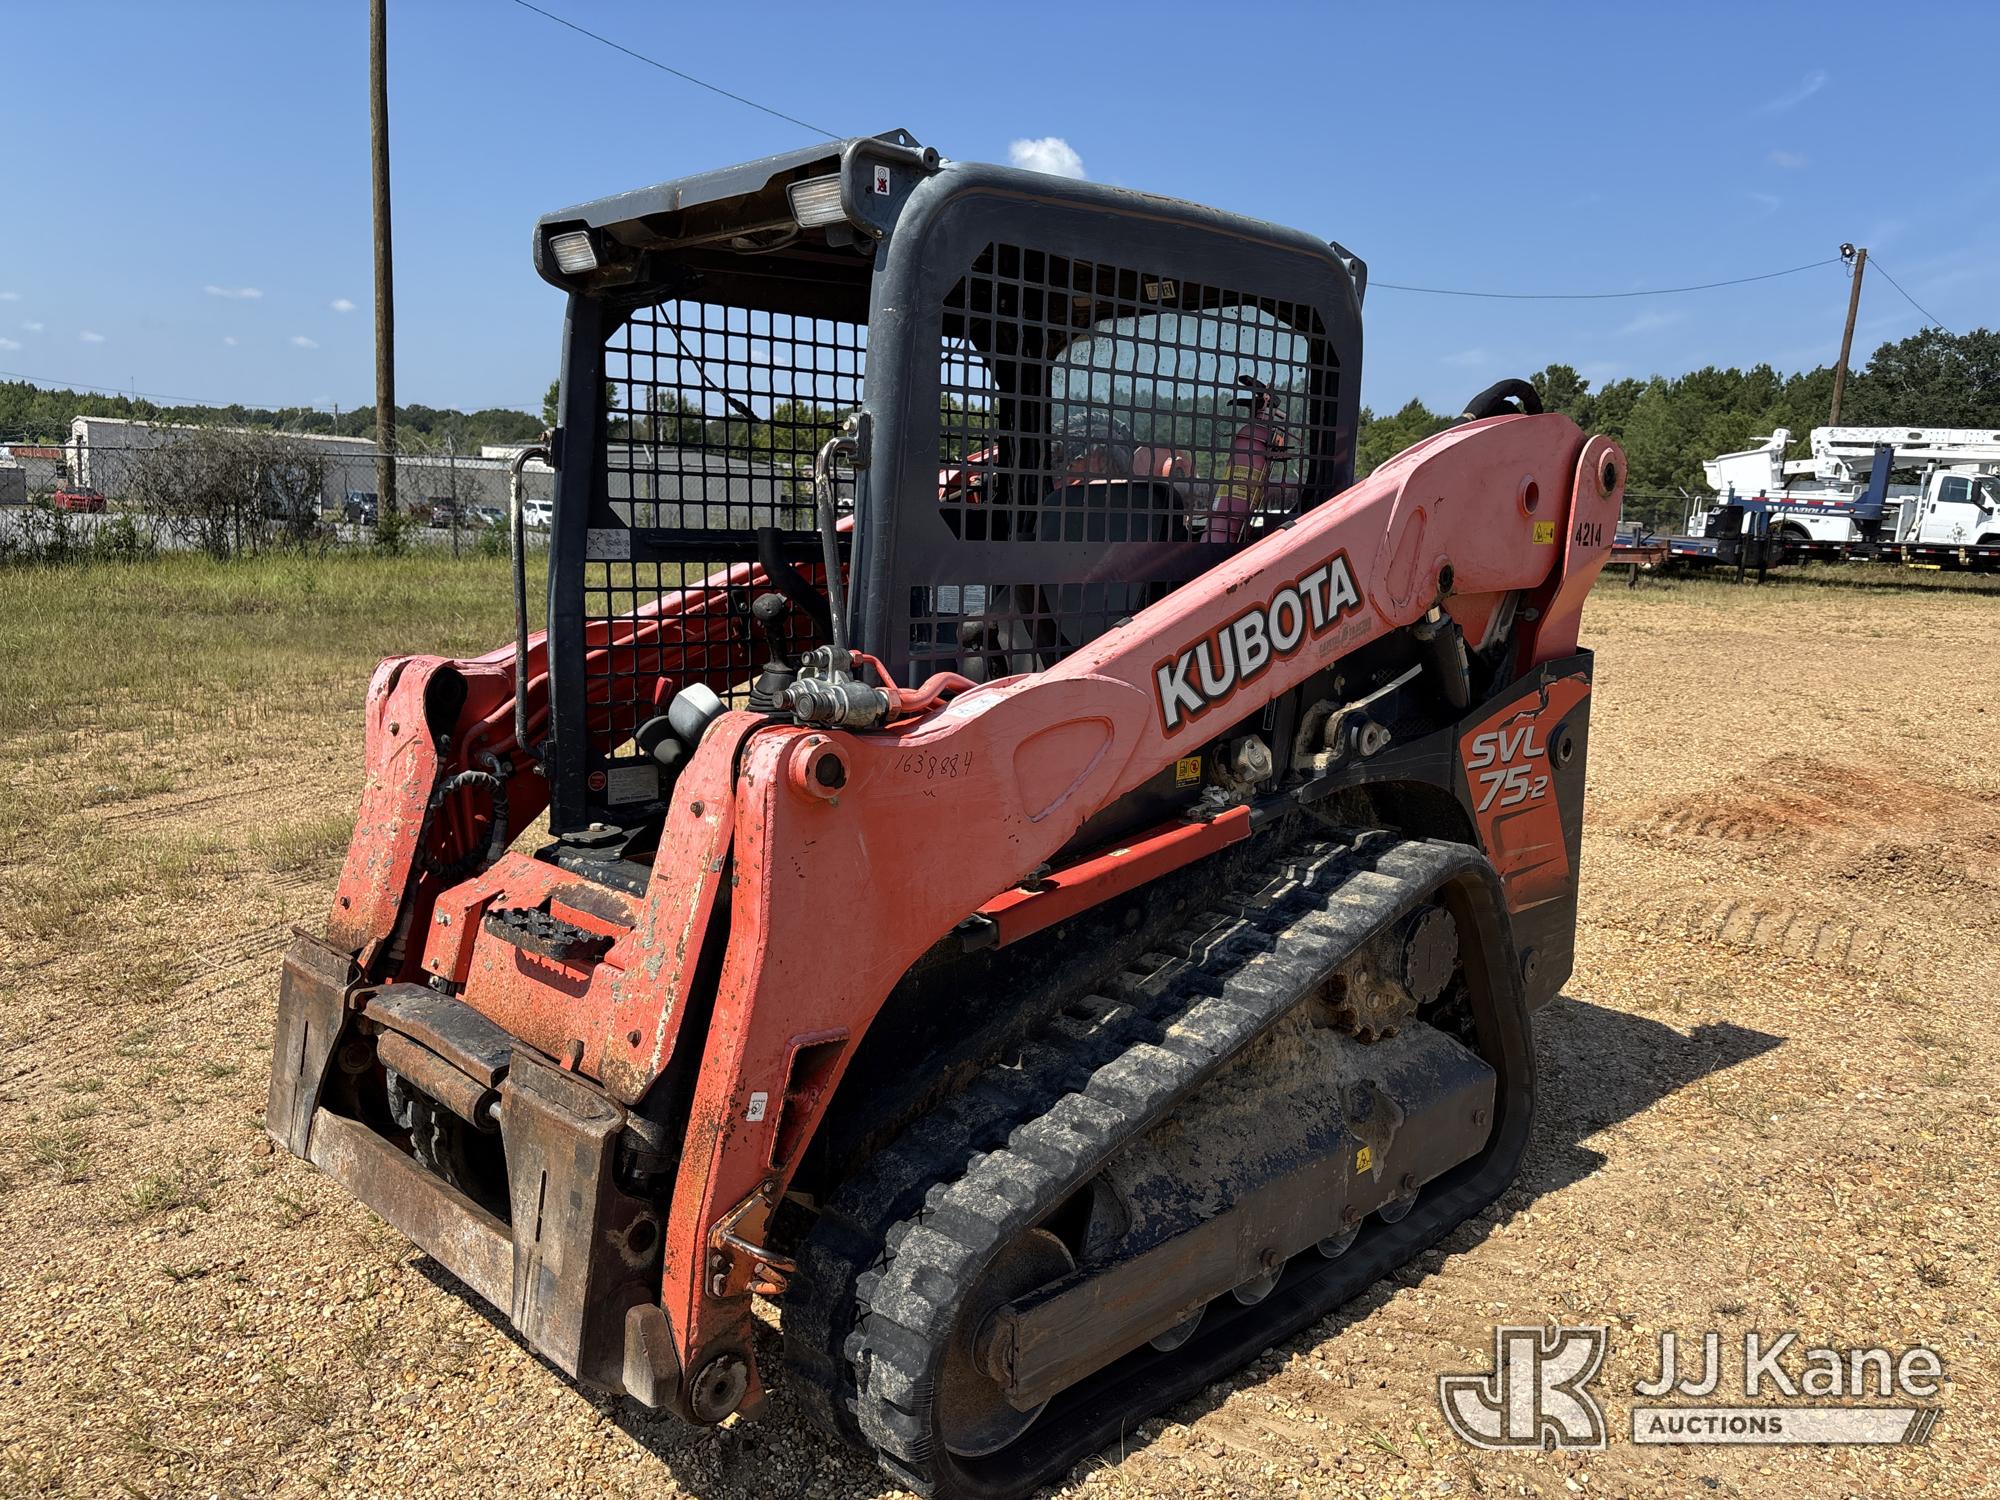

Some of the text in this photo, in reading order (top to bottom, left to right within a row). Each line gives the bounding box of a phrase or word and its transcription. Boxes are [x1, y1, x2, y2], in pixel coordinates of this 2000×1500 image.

[1780, 505, 1829, 514] LANDOLL
[1575, 522, 1602, 547] 4214
[1156, 556, 1359, 729] KUBOTA
[1467, 725, 1545, 770] SVL
[894, 751, 973, 780] 1638884
